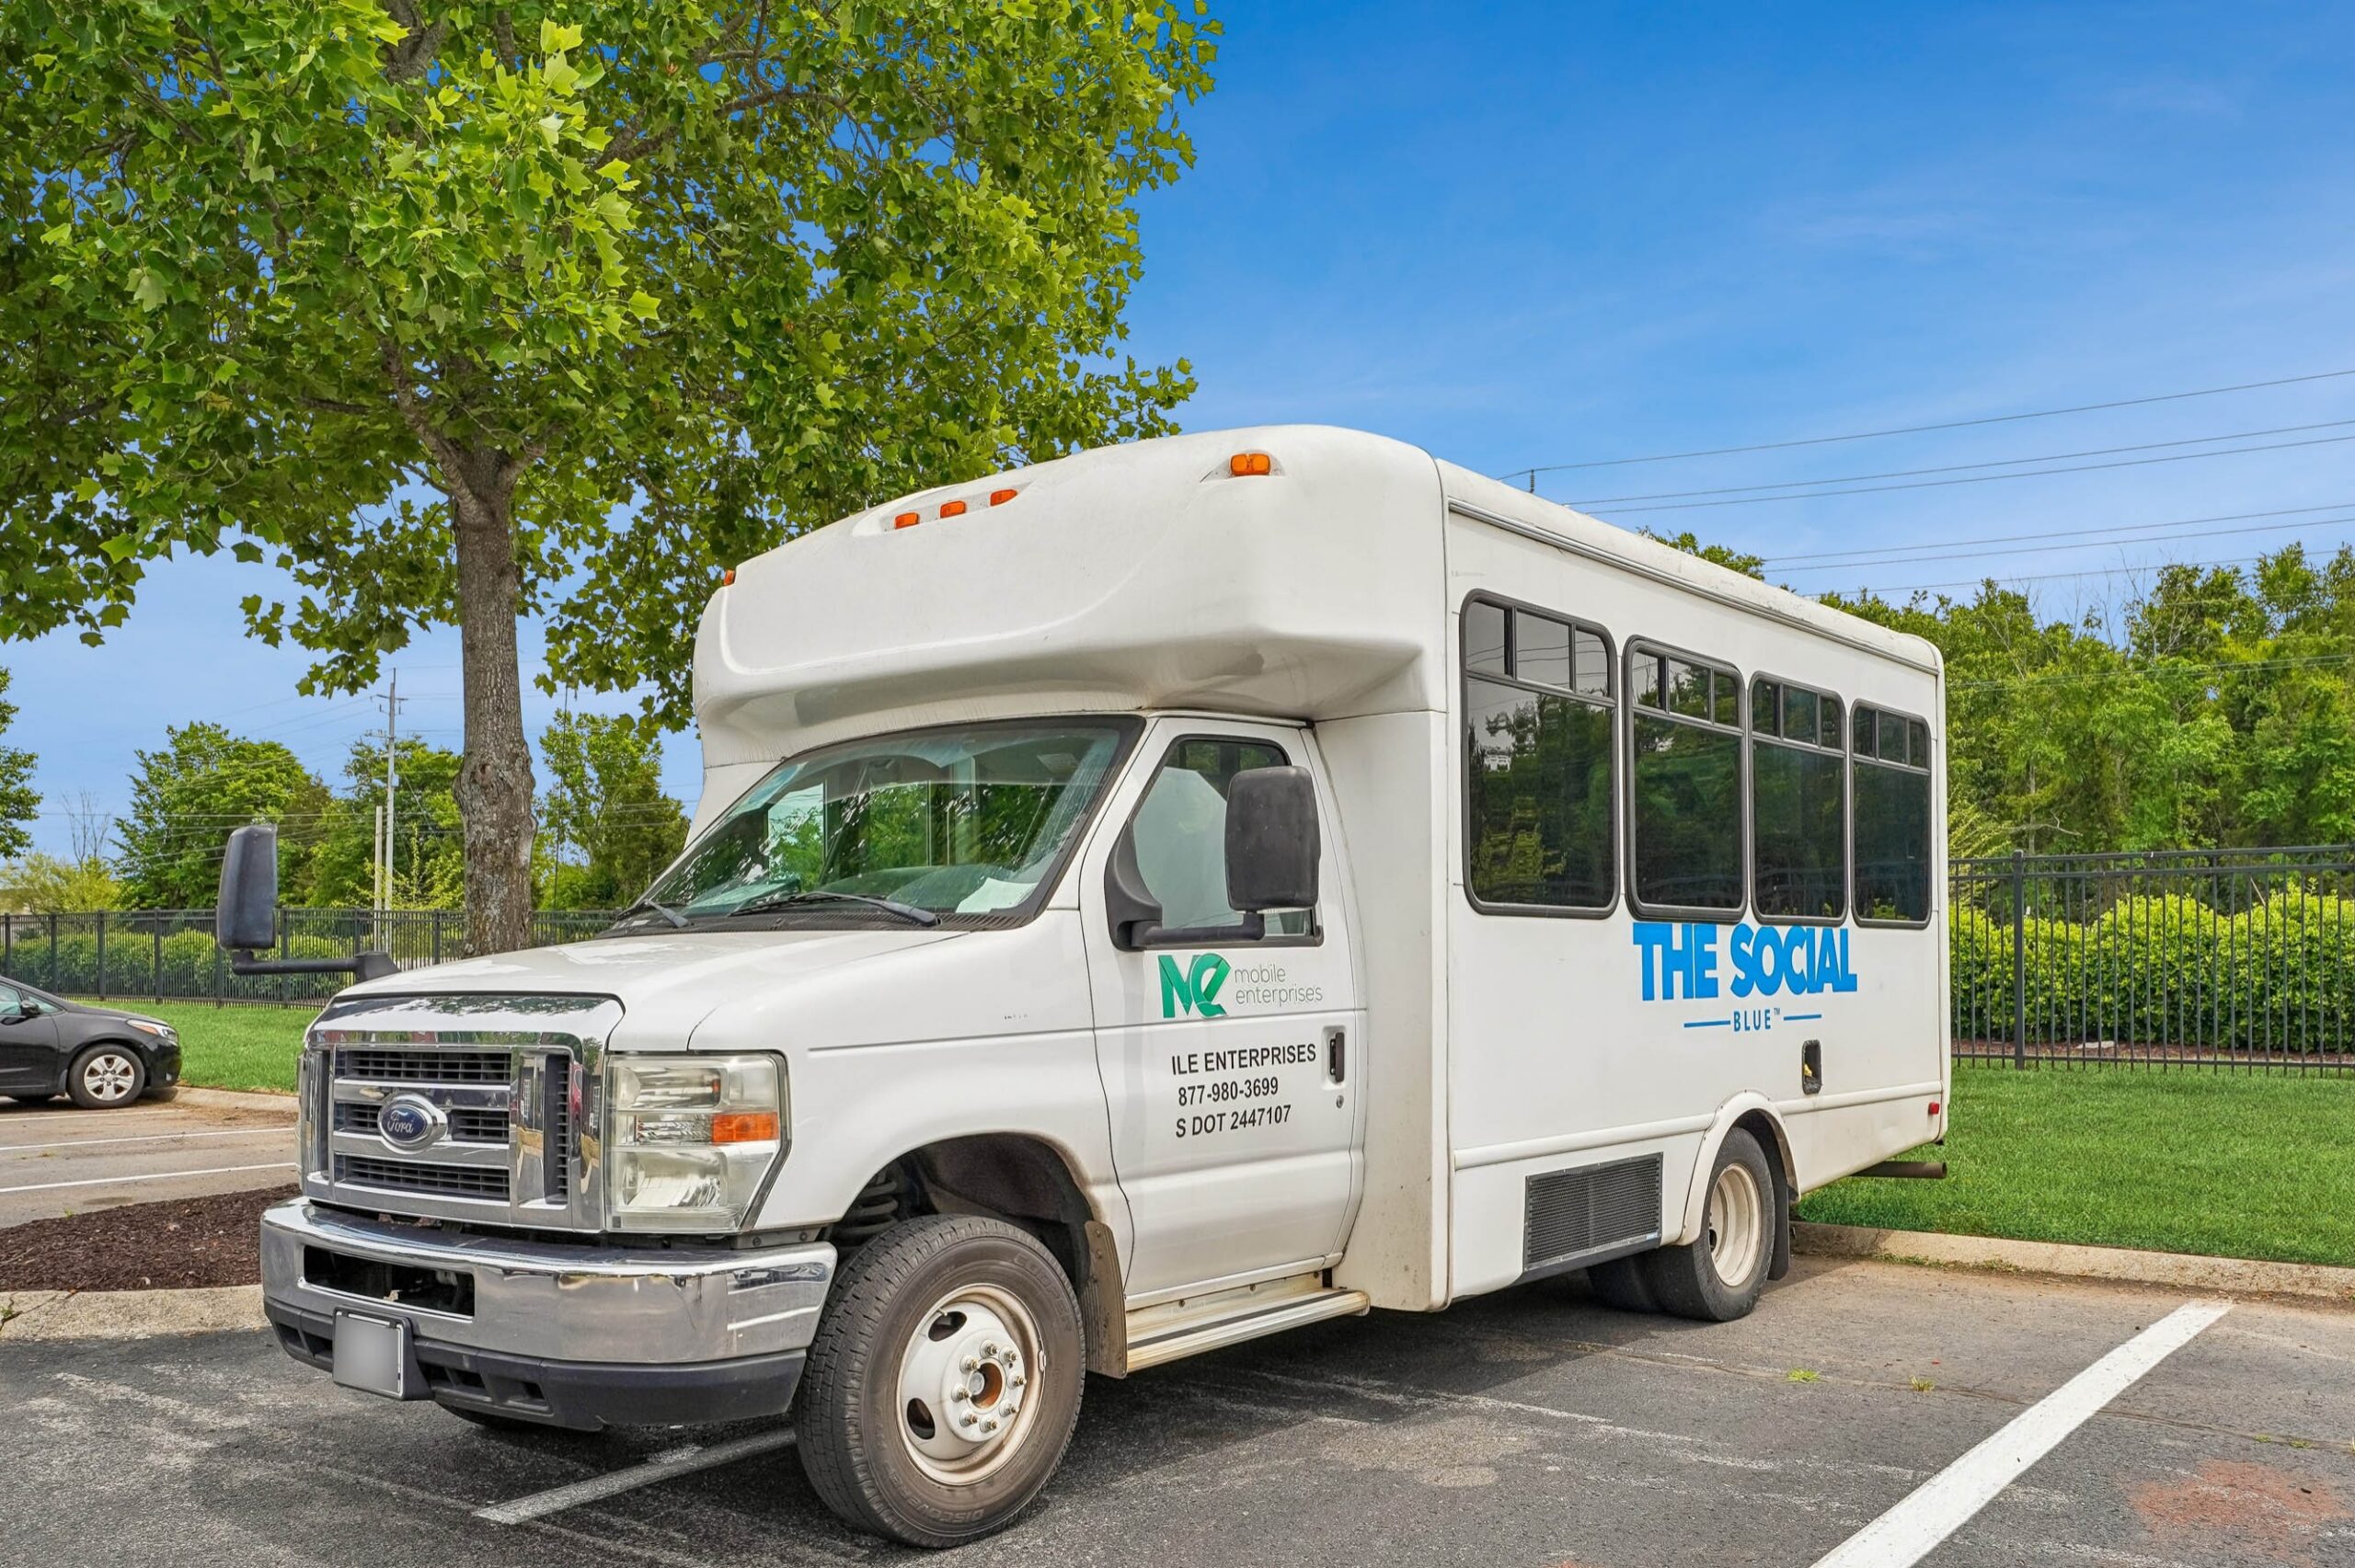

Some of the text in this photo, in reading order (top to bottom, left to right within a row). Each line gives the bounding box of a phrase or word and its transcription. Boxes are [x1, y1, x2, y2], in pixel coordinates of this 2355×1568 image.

[1235, 964, 1286, 983] mobile
[1633, 922, 1857, 1001] THE SOCIAL
[1235, 985, 1324, 1008] enterprises
[1733, 1009, 1771, 1032] BLUE
[1171, 1043, 1316, 1075] ILE ENTERPRISES
[1178, 1077, 1279, 1106] 877-980-3699
[388, 1109, 414, 1134] Ford
[1176, 1104, 1292, 1138] S DOT 2447107
